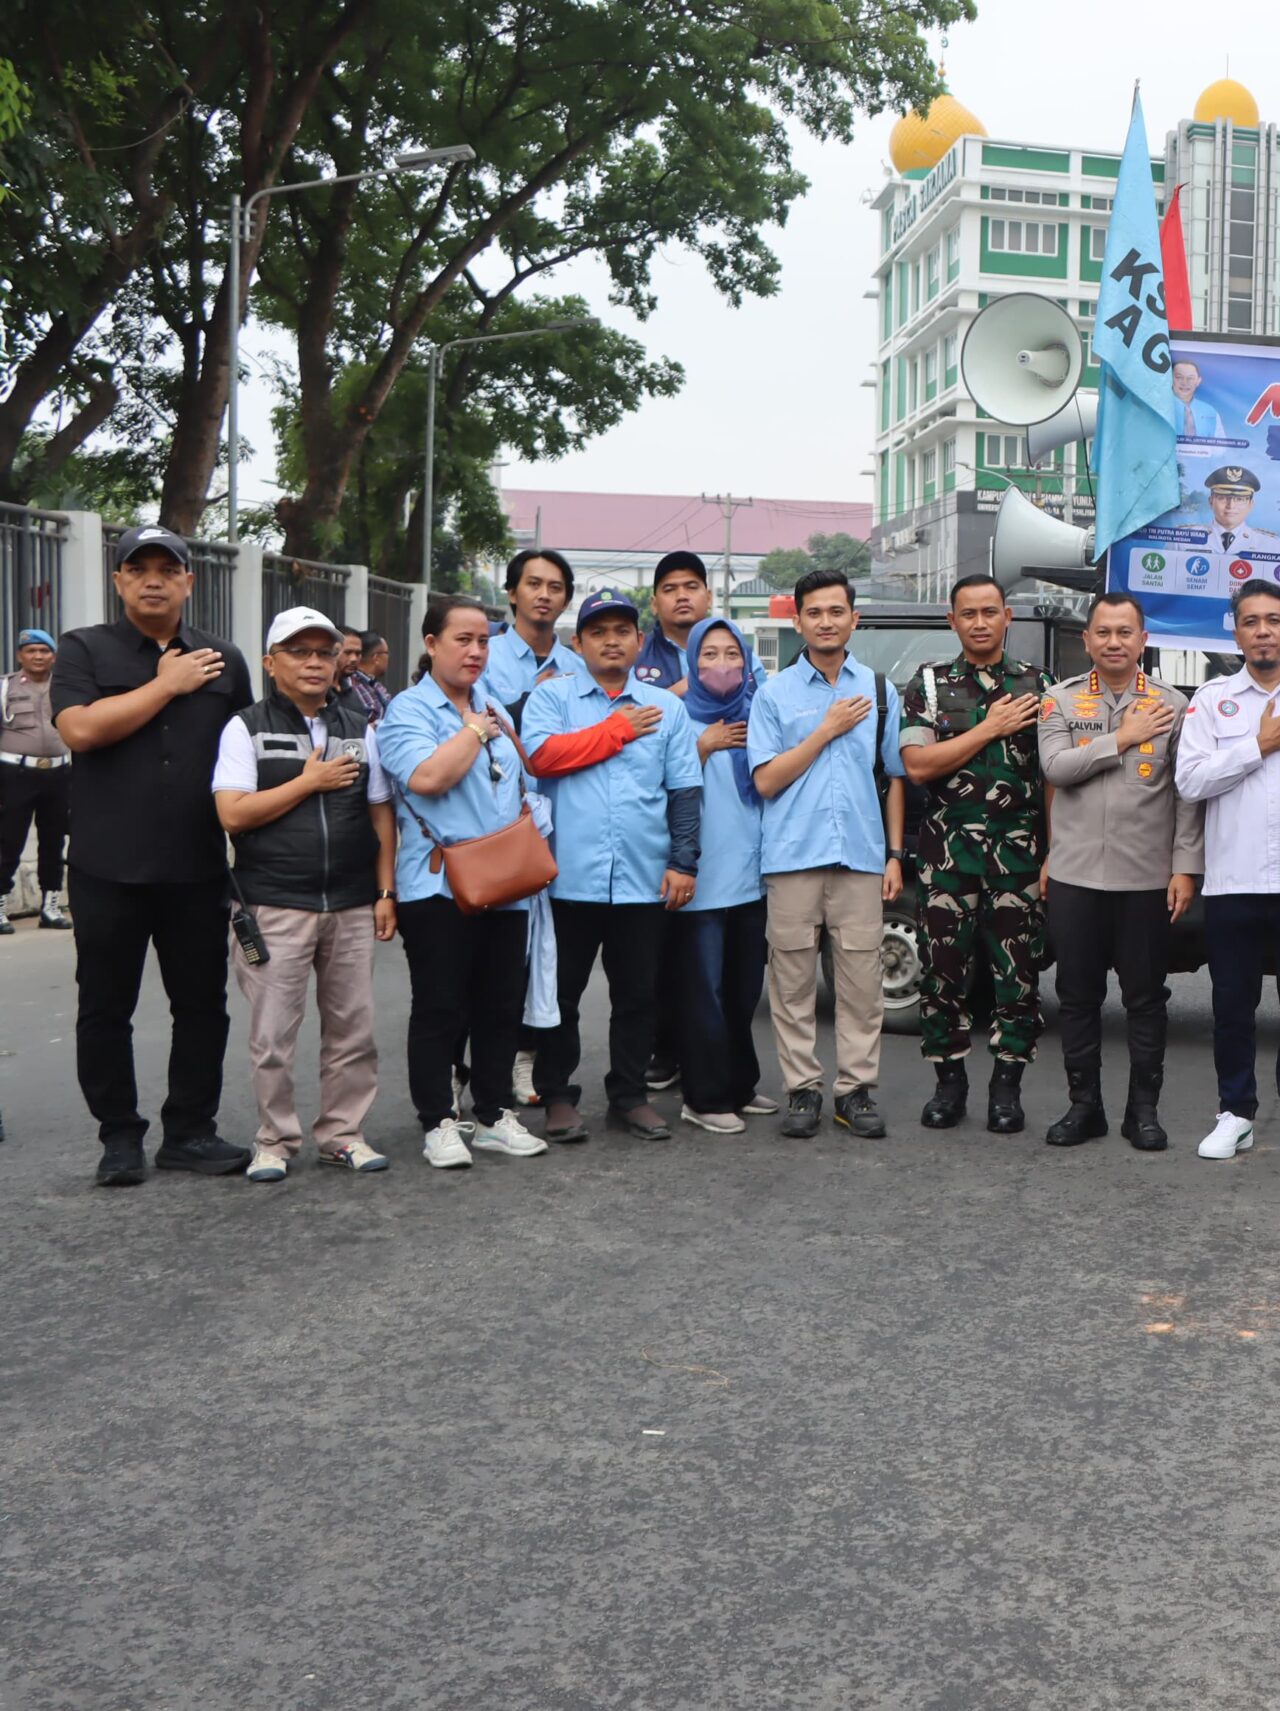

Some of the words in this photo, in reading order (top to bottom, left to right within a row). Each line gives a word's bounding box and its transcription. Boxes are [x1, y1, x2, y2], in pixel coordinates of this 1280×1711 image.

[1143, 573, 1163, 581] JALAN
[1186, 577, 1208, 585] SENAM
[1142, 580, 1164, 588] SANTAI
